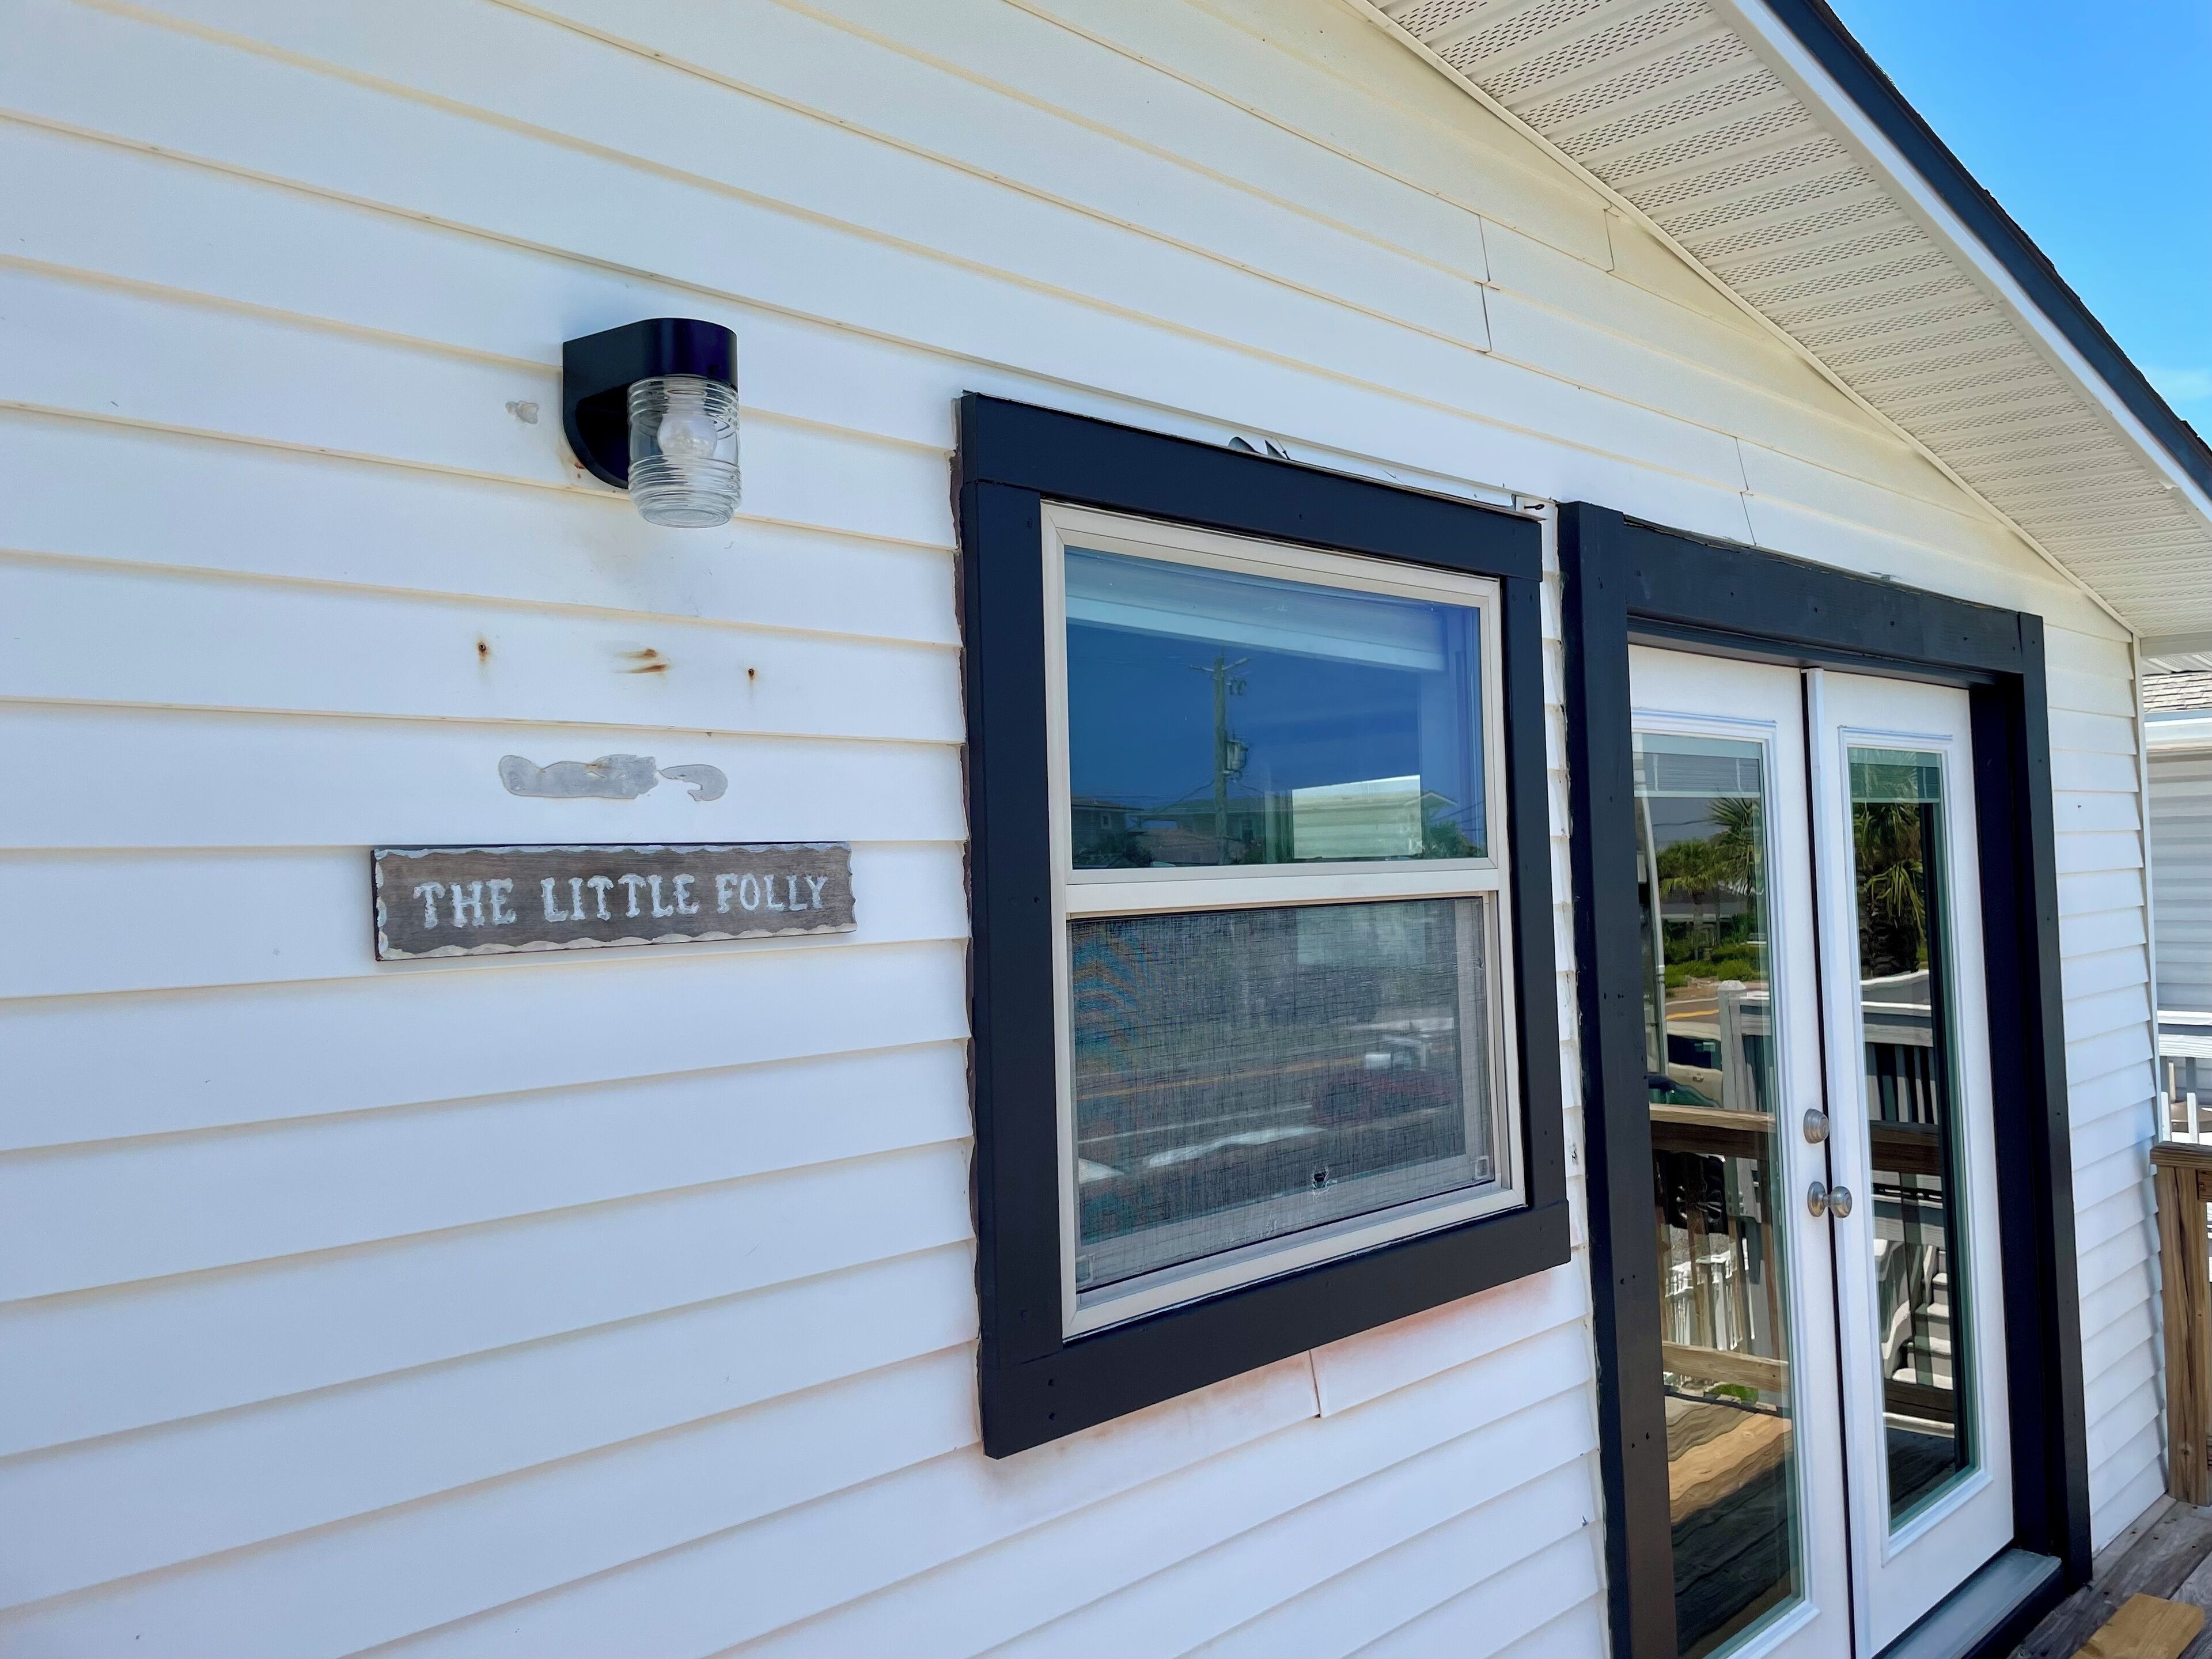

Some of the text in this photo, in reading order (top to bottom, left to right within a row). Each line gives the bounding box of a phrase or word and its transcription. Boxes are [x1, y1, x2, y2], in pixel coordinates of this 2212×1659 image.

[413, 872, 828, 929] THE LITTLE FOLLY
